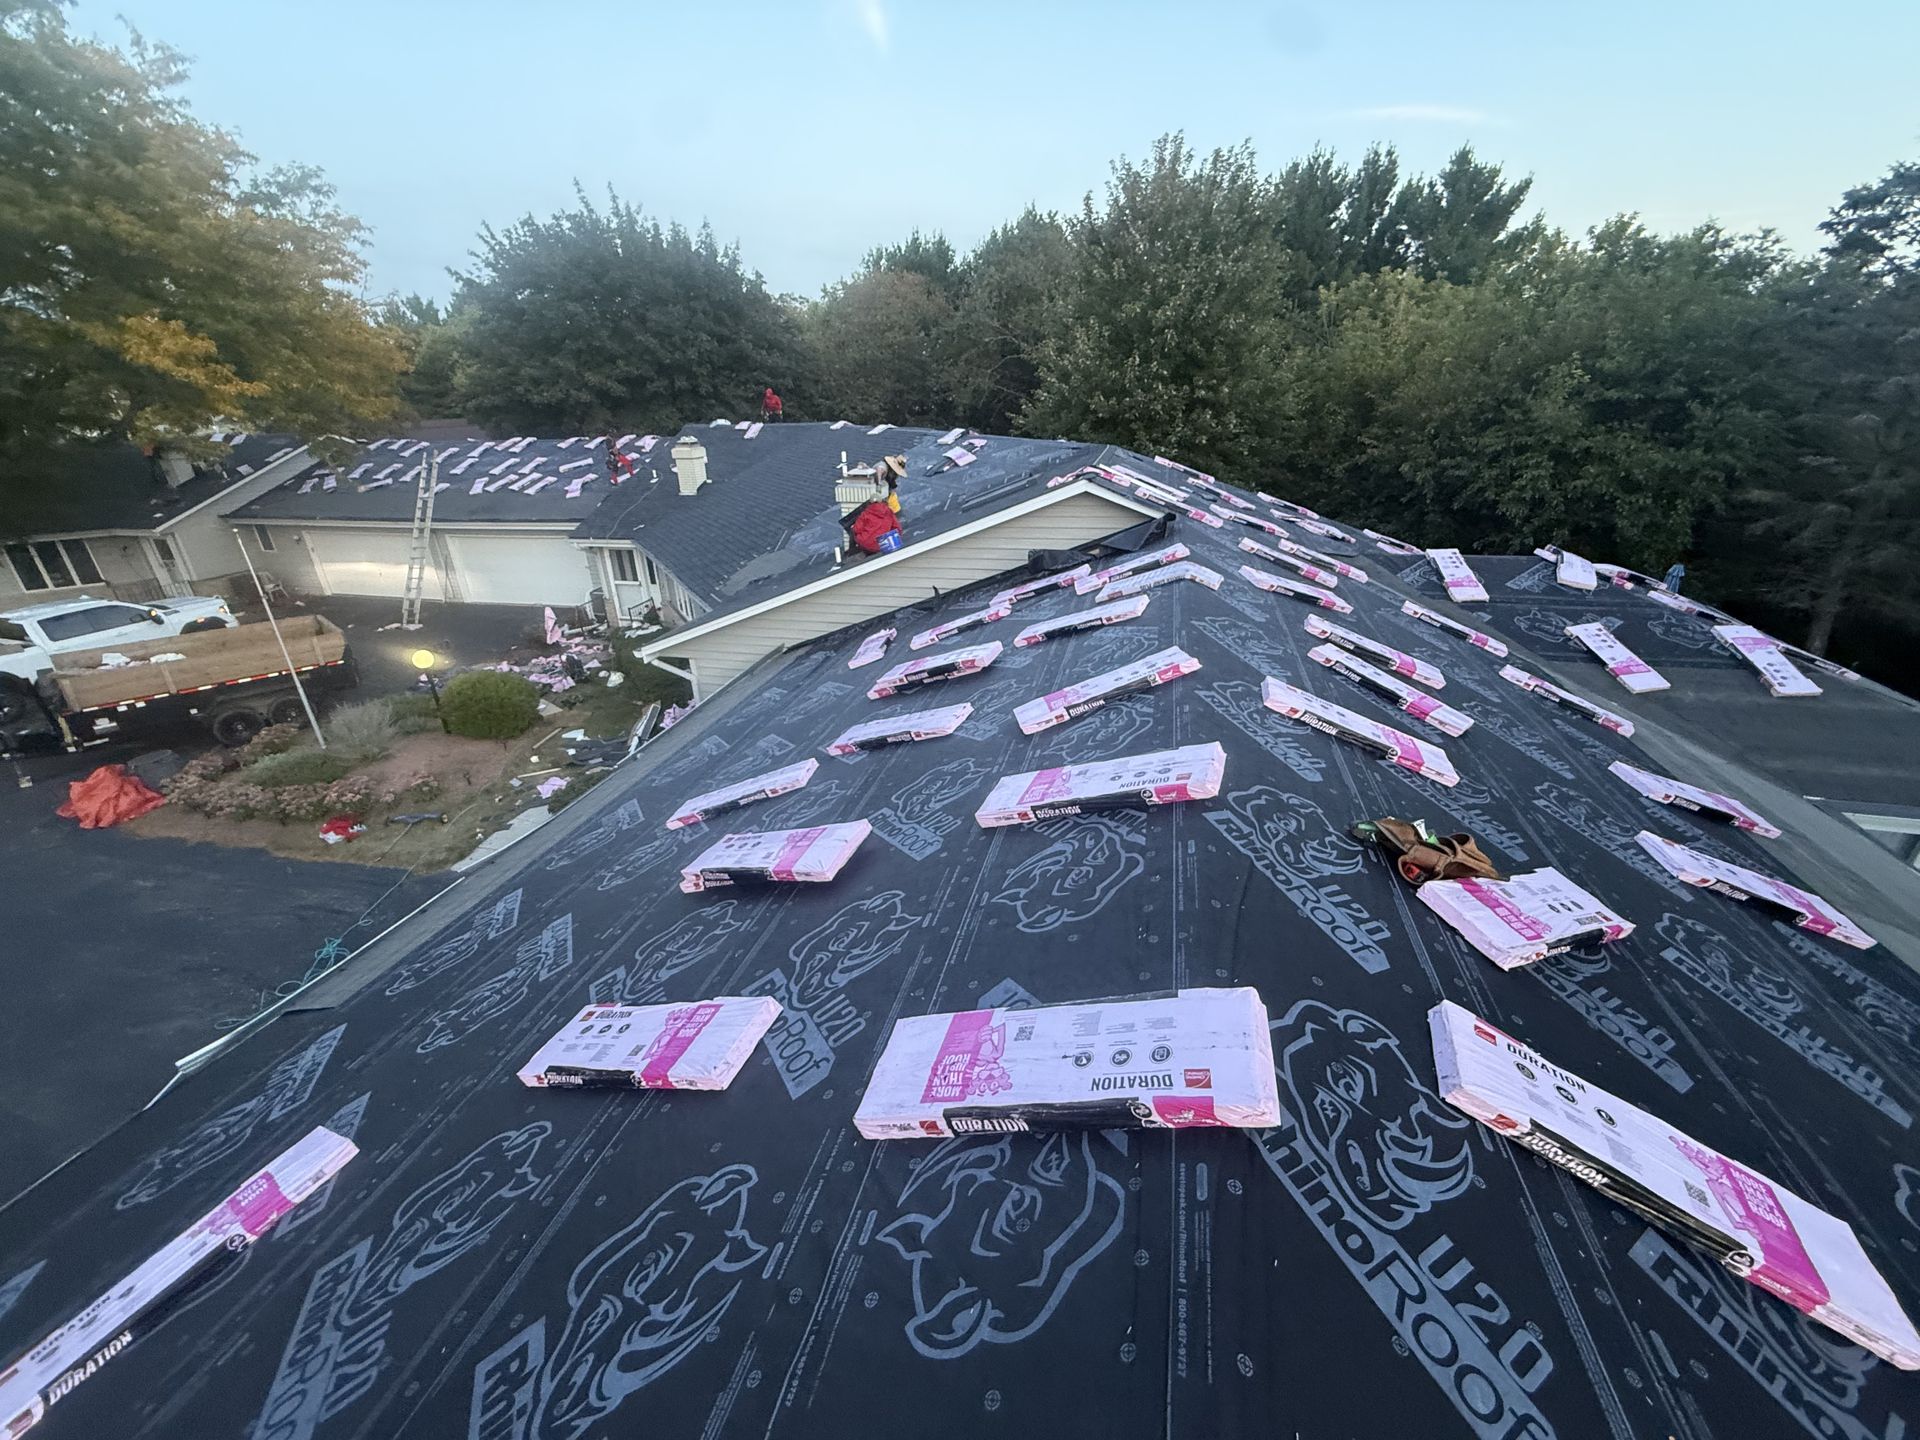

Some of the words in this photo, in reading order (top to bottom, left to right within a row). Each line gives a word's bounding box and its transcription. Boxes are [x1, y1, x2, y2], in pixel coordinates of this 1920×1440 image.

[1300, 713, 1339, 736] DURATION
[1119, 775, 1171, 789] DURATION
[1214, 817, 1381, 956] RhinoRoof
[1318, 884, 1392, 942] U20
[813, 993, 866, 1048] U20
[1590, 986, 1677, 1054] U20
[940, 1053, 971, 1065] ROOF
[1091, 1073, 1174, 1092] DURATION
[1507, 1043, 1588, 1094] DURATION
[1798, 1026, 1885, 1089] U20
[929, 1085, 963, 1097] MORE
[951, 1117, 1030, 1133] DURATION
[1262, 1124, 1549, 1440] hinoRoof
[1417, 1234, 1553, 1393] U20
[48, 1328, 133, 1406] DURATION
